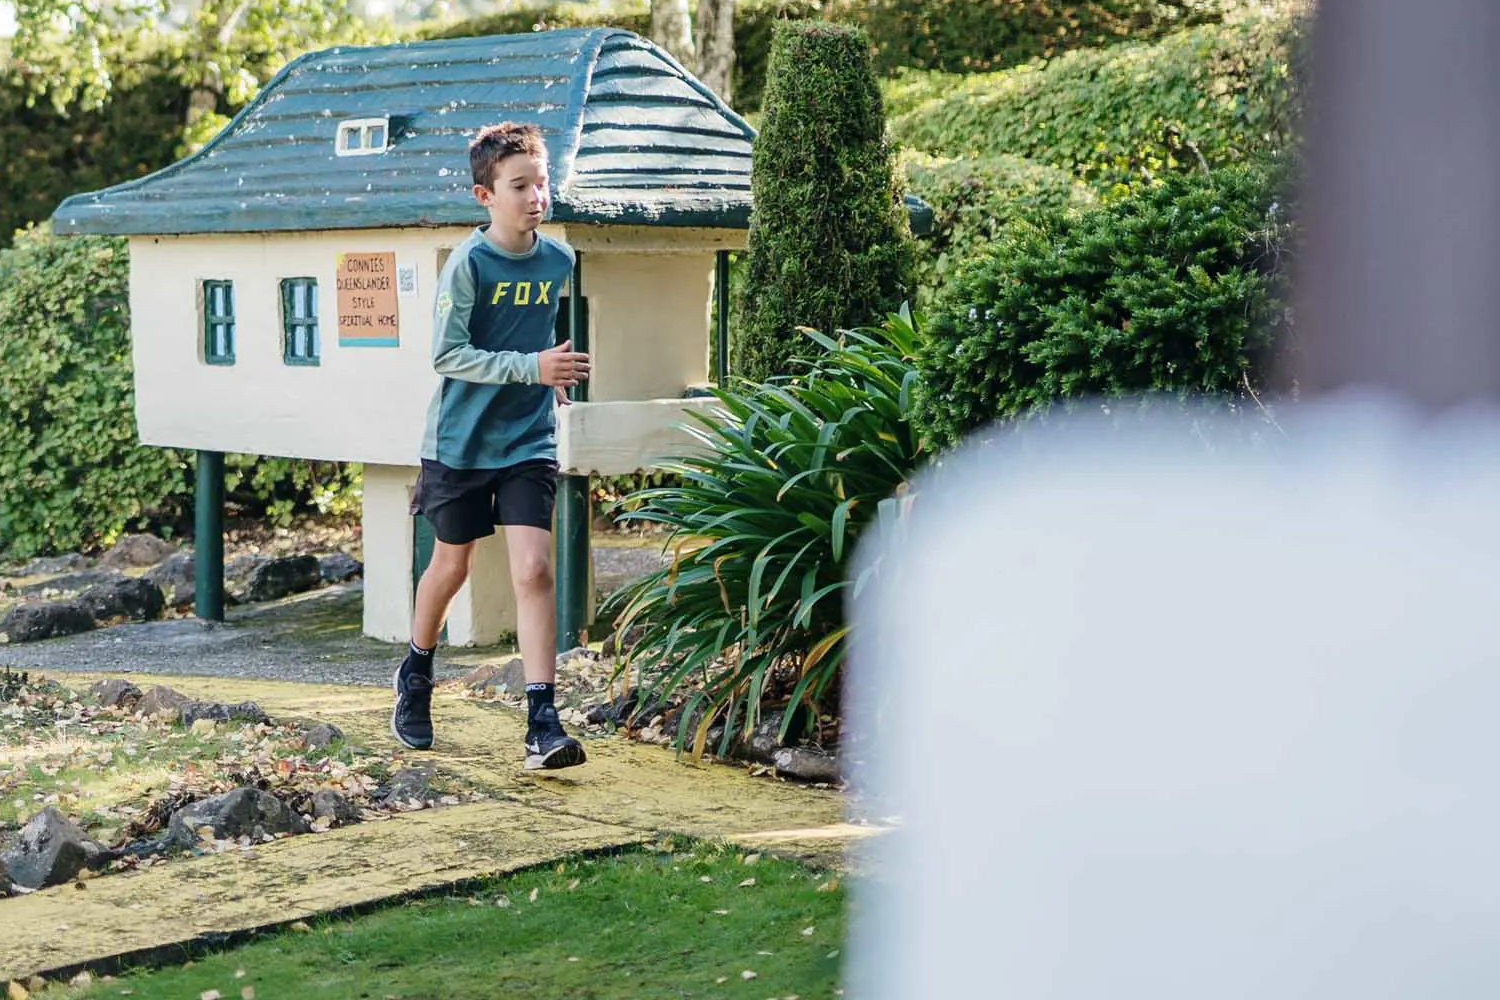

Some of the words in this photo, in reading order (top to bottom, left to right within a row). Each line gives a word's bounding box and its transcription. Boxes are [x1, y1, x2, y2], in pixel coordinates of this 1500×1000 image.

[337, 276, 390, 290] QUEENSLANDER
[491, 281, 552, 305] FOX
[352, 297, 375, 309] STYLE
[378, 313, 397, 326] HOME
